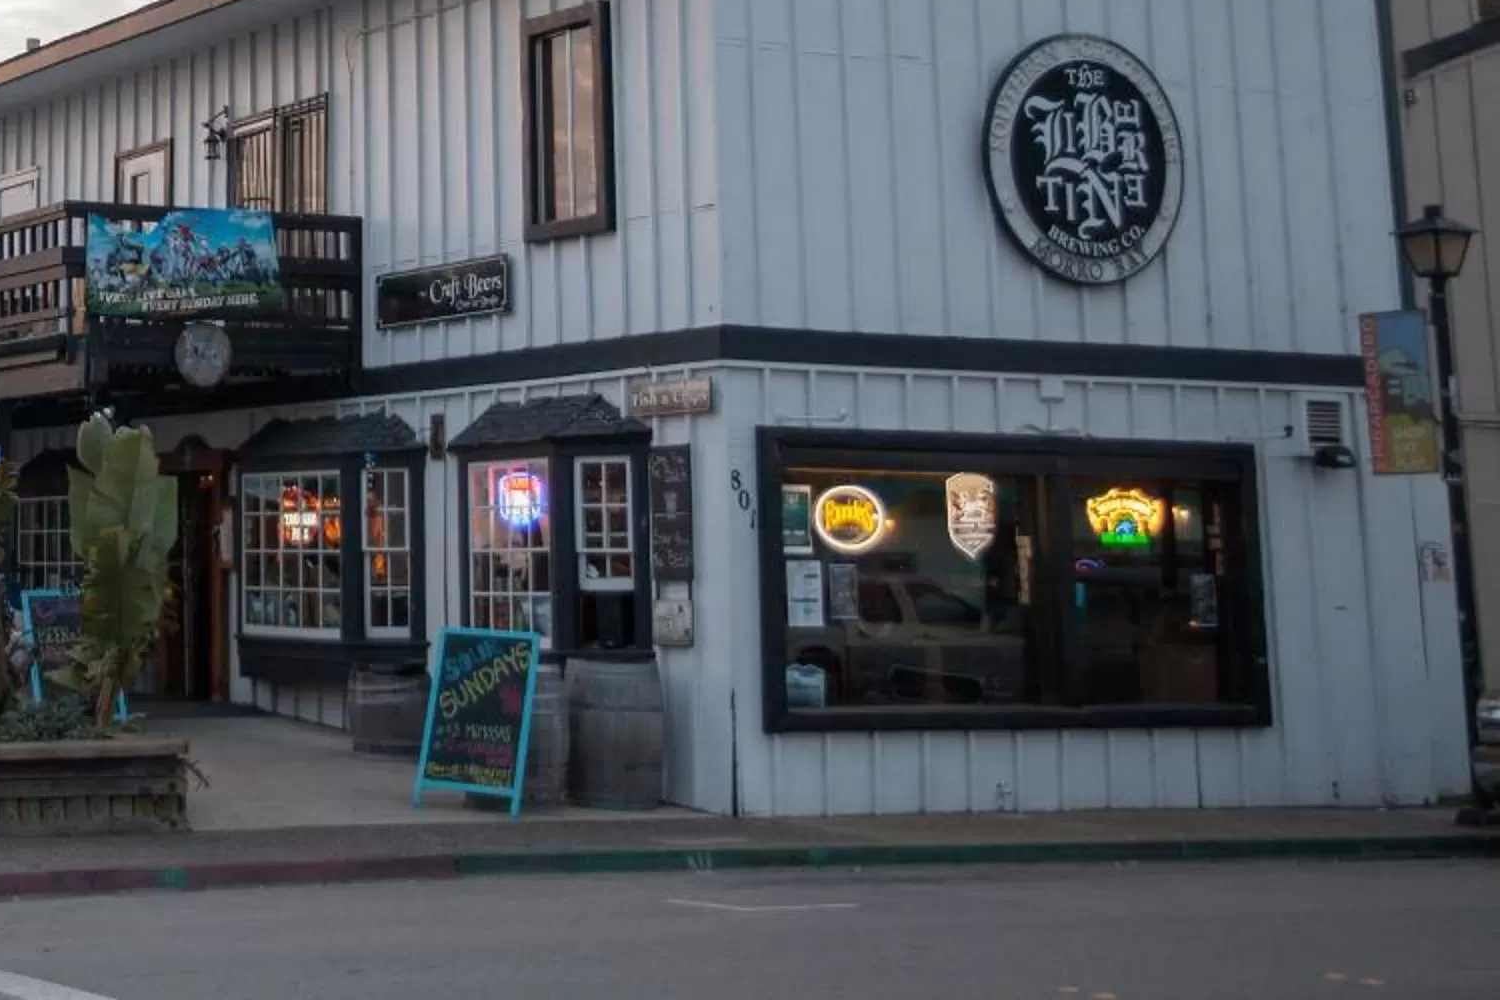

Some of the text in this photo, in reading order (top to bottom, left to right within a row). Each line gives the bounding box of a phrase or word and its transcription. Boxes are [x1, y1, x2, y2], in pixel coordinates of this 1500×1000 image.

[1064, 64, 1105, 87] THE
[1047, 224, 1121, 257] BREWING
[429, 276, 462, 305] Craft
[464, 273, 503, 299] Beers
[731, 469, 757, 530] 801
[439, 641, 532, 719] SUNDAYS
